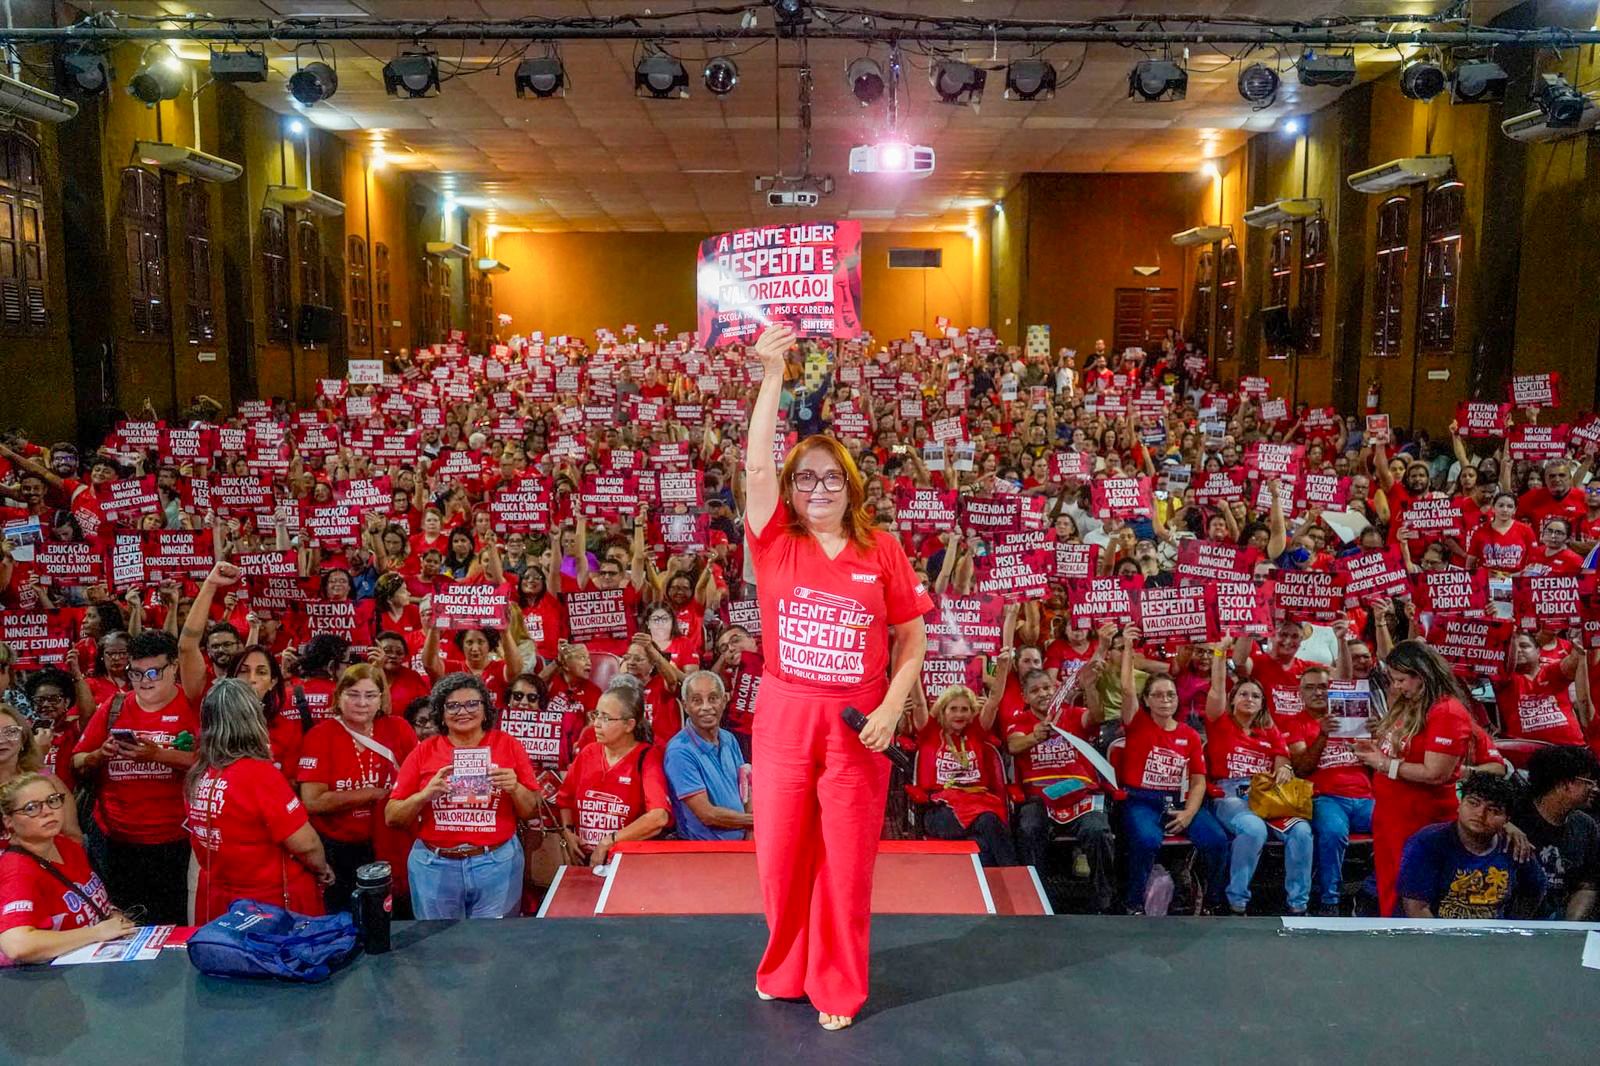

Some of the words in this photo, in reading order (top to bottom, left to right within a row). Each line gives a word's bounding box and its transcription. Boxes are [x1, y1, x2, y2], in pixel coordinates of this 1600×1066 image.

[719, 238, 728, 252] A
[733, 229, 785, 249] GENTE
[790, 226, 833, 244] QUER
[823, 249, 833, 269] E
[719, 314, 742, 323] ESCOLA
[775, 307, 790, 315] PISO
[800, 306, 834, 314] CARREIRA
[802, 320, 833, 330] SINTEPE
[1468, 403, 1498, 412] DEFENDA
[1474, 412, 1497, 420] ESCOLA
[1469, 419, 1494, 427] PÚBLICA
[170, 439, 175, 447] A
[176, 439, 200, 447] ESCOLA
[1258, 444, 1291, 454] DEFENDA
[1265, 455, 1291, 463] ESCOLA
[1259, 461, 1287, 472] PÚBLICA
[1104, 479, 1139, 488] DEFENDA
[915, 491, 930, 500] PISO
[933, 491, 938, 500] E
[1113, 489, 1140, 497] ESCOLA
[1196, 487, 1219, 496] ANDAM
[1220, 486, 1242, 494] JUNTOS
[909, 501, 944, 510] CARREIRA
[1109, 497, 1138, 506] PÚBLICA
[315, 508, 348, 517] EDUCAÇÃO
[967, 502, 1004, 514] MERENDA
[1005, 505, 1016, 513] DE
[898, 510, 925, 519] ANDAM
[927, 510, 955, 519] JUNTOS
[305, 515, 329, 526] PÚBLICA
[969, 516, 1013, 525] QUALIDADE
[314, 527, 350, 535] SOBERANO!
[160, 535, 171, 543] NO
[172, 535, 193, 543] CALOR
[48, 545, 89, 556] EDUCAÇÃO
[161, 544, 194, 554] NINGUÉM
[1200, 545, 1212, 554] NO
[1213, 547, 1236, 557] CALOR
[36, 553, 66, 563] PÚBLICA
[76, 553, 102, 563] BRASIL
[145, 557, 180, 565] CONSEGUE
[181, 556, 213, 565] ESTUDAR
[996, 555, 1014, 567] PISO
[1016, 554, 1023, 564] E
[1198, 556, 1234, 568] NINGUÉM
[1347, 560, 1359, 569] NO
[1361, 553, 1383, 566] CALOR
[47, 565, 91, 573] SOBERANO!
[990, 564, 1032, 579] CARREIRA
[1178, 565, 1216, 578] CONSEGUE
[1218, 572, 1251, 581] ESTUDAR
[1351, 566, 1386, 581] NINGUÉM
[269, 578, 288, 588] PISO
[291, 579, 297, 588] E
[980, 579, 1012, 592] ANDAM
[1014, 574, 1047, 587] JUNTOS
[1285, 573, 1331, 587] EDUCAÇÃO
[1376, 570, 1407, 588] ESTUDAR
[1427, 572, 1471, 585] DEFENDA
[1531, 577, 1578, 589] DEFENDA
[1092, 580, 1112, 590] PISO
[1114, 579, 1120, 589] E
[264, 589, 307, 598] CARREIRA
[449, 585, 494, 596] EDUCAÇÃO
[568, 593, 573, 601] A
[575, 592, 600, 601] GENTE
[602, 590, 623, 600] QUER
[1085, 590, 1129, 602] CARREIRA
[1141, 591, 1146, 600] A
[1149, 589, 1178, 599] GENTE
[1180, 587, 1203, 597] QUER
[1315, 586, 1343, 596] BRASIL
[1429, 587, 1435, 596] A
[1438, 585, 1472, 596] ESCOLA
[1532, 591, 1539, 601] A
[1542, 590, 1580, 601] ESCOLA
[253, 598, 286, 607] ANDAM
[434, 594, 469, 604] PÚBLICA
[479, 595, 506, 605] BRASIL
[942, 600, 954, 609] NO
[955, 600, 981, 610] CALOR
[1218, 596, 1256, 608] ESCOLA
[1281, 596, 1330, 608] SOBERANO!
[1433, 597, 1470, 608] PÚBLICA
[306, 604, 355, 615] DEFENDA
[445, 606, 494, 615] SOBERANO!
[568, 600, 615, 615] RESPEITO
[619, 601, 624, 610] E
[779, 599, 785, 613] A
[790, 603, 836, 621] GENTE
[839, 610, 874, 626] QUER
[1073, 603, 1107, 615] ANDAM
[1142, 599, 1194, 616] RESPEITO
[1198, 599, 1204, 611] E
[1536, 602, 1576, 614] PÚBLICA
[4, 616, 18, 625] NO
[20, 615, 47, 624] CALOR
[572, 614, 623, 627] VALORIZAÇÃO!
[942, 611, 980, 622] NINGUÉM
[1145, 615, 1202, 629] VALORIZAÇÃO!
[308, 617, 315, 628] A
[318, 617, 355, 628] ESCOLA
[1447, 622, 1460, 632] NO
[1462, 623, 1488, 634] CALOR
[5, 625, 48, 638] NINGUÉM
[779, 615, 854, 648] RESPEITO
[859, 631, 866, 649] E
[964, 626, 1000, 636] ESTUDAR
[31, 638, 69, 649] ESTUDAR
[1446, 634, 1485, 646] NINGUÉM
[781, 644, 860, 672] VALORIZAÇÃO!
[1467, 648, 1505, 661] ESTUDAR
[923, 661, 965, 671] DEFENDA
[924, 673, 930, 683] A
[932, 673, 965, 684] ESCOLA
[739, 674, 752, 697] CALOR
[736, 700, 746, 711] NO
[502, 710, 507, 719] A
[510, 710, 537, 720] GENTE
[540, 712, 562, 722] QUER
[555, 726, 561, 737] E
[582, 800, 606, 811] GENTE
[608, 802, 630, 814] QUER
[436, 812, 494, 824] VALORIZAÇÃO!
